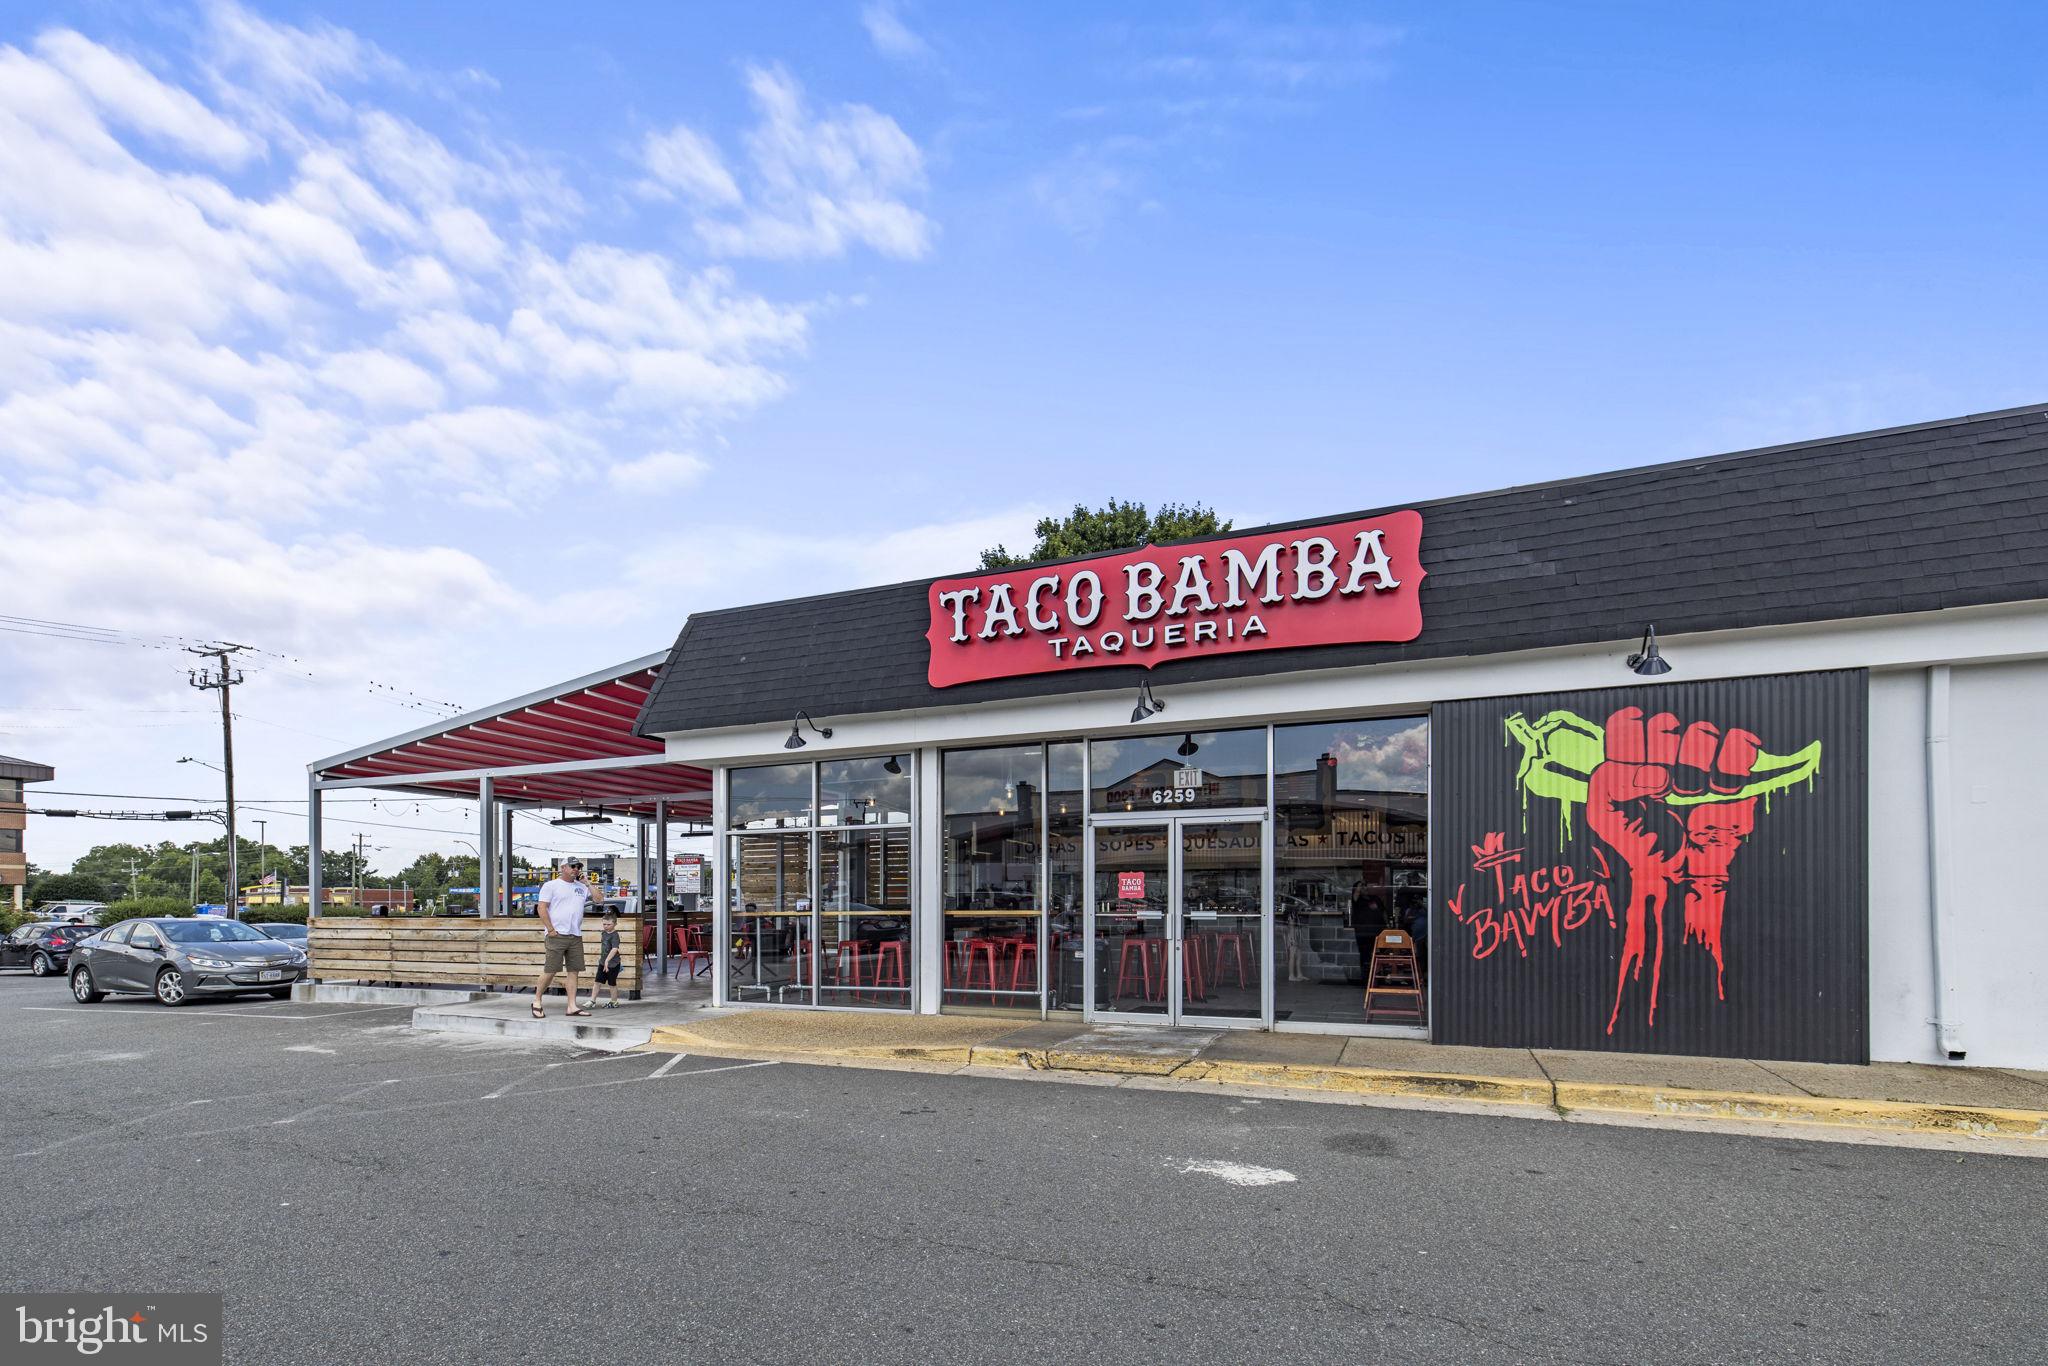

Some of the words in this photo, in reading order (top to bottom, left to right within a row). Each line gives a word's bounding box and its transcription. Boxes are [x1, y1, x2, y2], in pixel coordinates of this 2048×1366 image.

[939, 570, 1107, 643] TACO
[1122, 529, 1402, 621] BAMBA
[1048, 615, 1268, 657] TAQUERIA
[1179, 771, 1197, 786] EXIT
[1152, 788, 1196, 804] 6259
[1100, 839, 1155, 851] SOPES
[1182, 834, 1309, 852] QUESADILAS
[1337, 830, 1405, 846] TACOS
[1466, 881, 1617, 959] BAMBA
